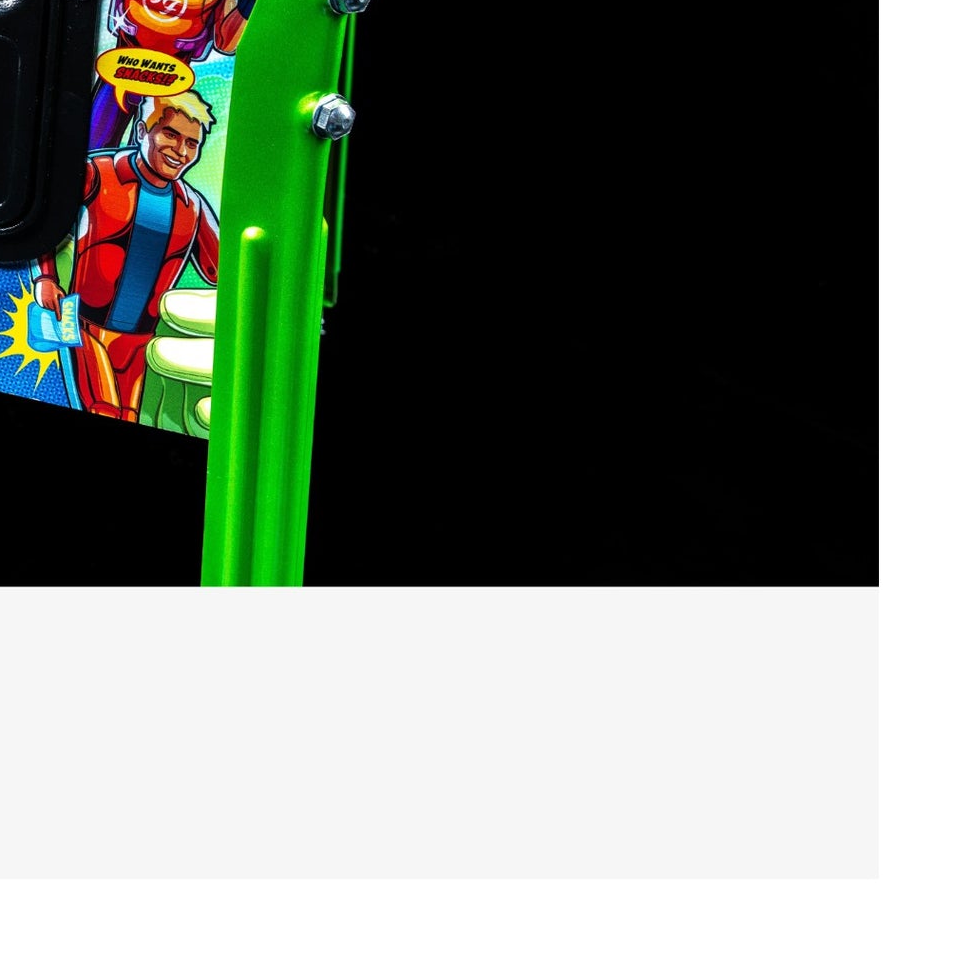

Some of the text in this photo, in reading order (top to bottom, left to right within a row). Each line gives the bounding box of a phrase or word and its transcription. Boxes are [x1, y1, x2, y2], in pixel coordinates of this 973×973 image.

[117, 55, 176, 73] WHO WANTS
[61, 301, 76, 342] SNACKS
